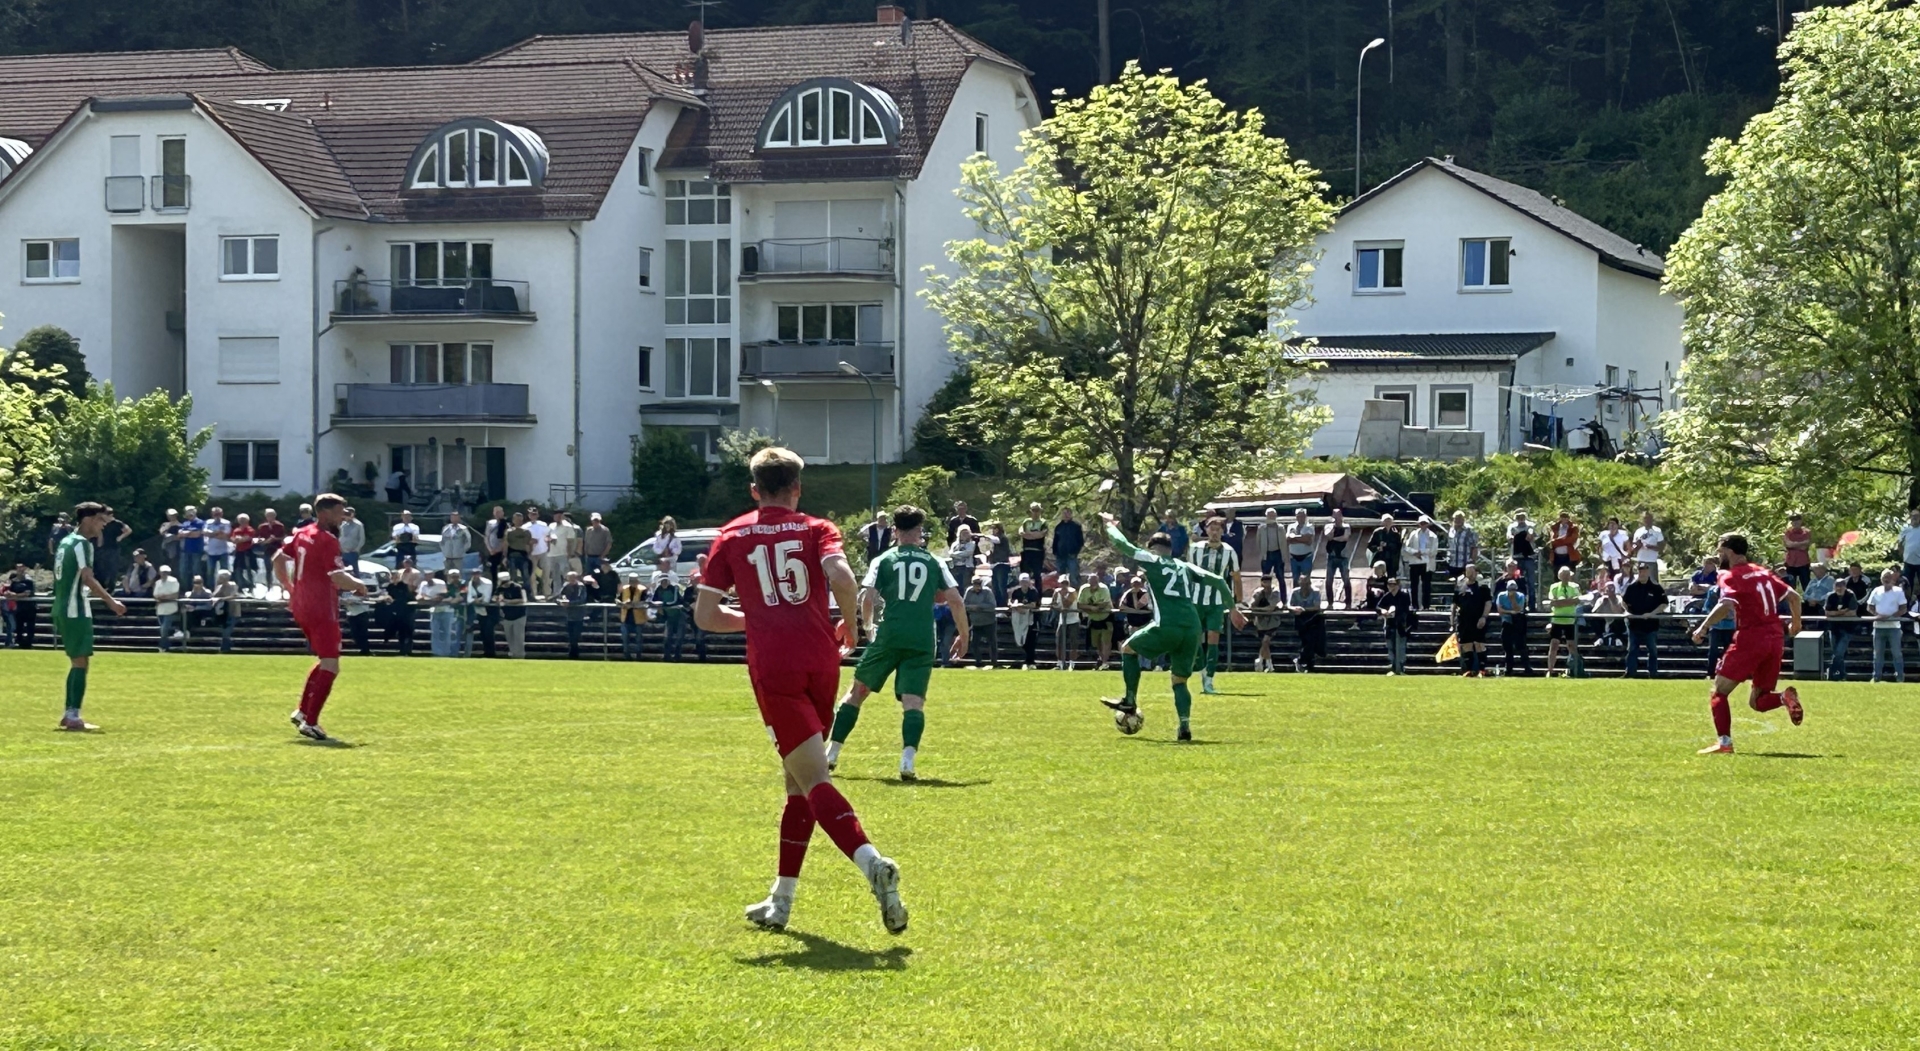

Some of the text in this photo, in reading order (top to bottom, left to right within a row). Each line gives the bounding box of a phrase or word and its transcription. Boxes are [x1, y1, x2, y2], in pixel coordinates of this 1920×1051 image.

[747, 540, 811, 606] 15
[893, 561, 928, 602] 19
[1162, 565, 1191, 598] 21
[1756, 580, 1777, 616] 11
